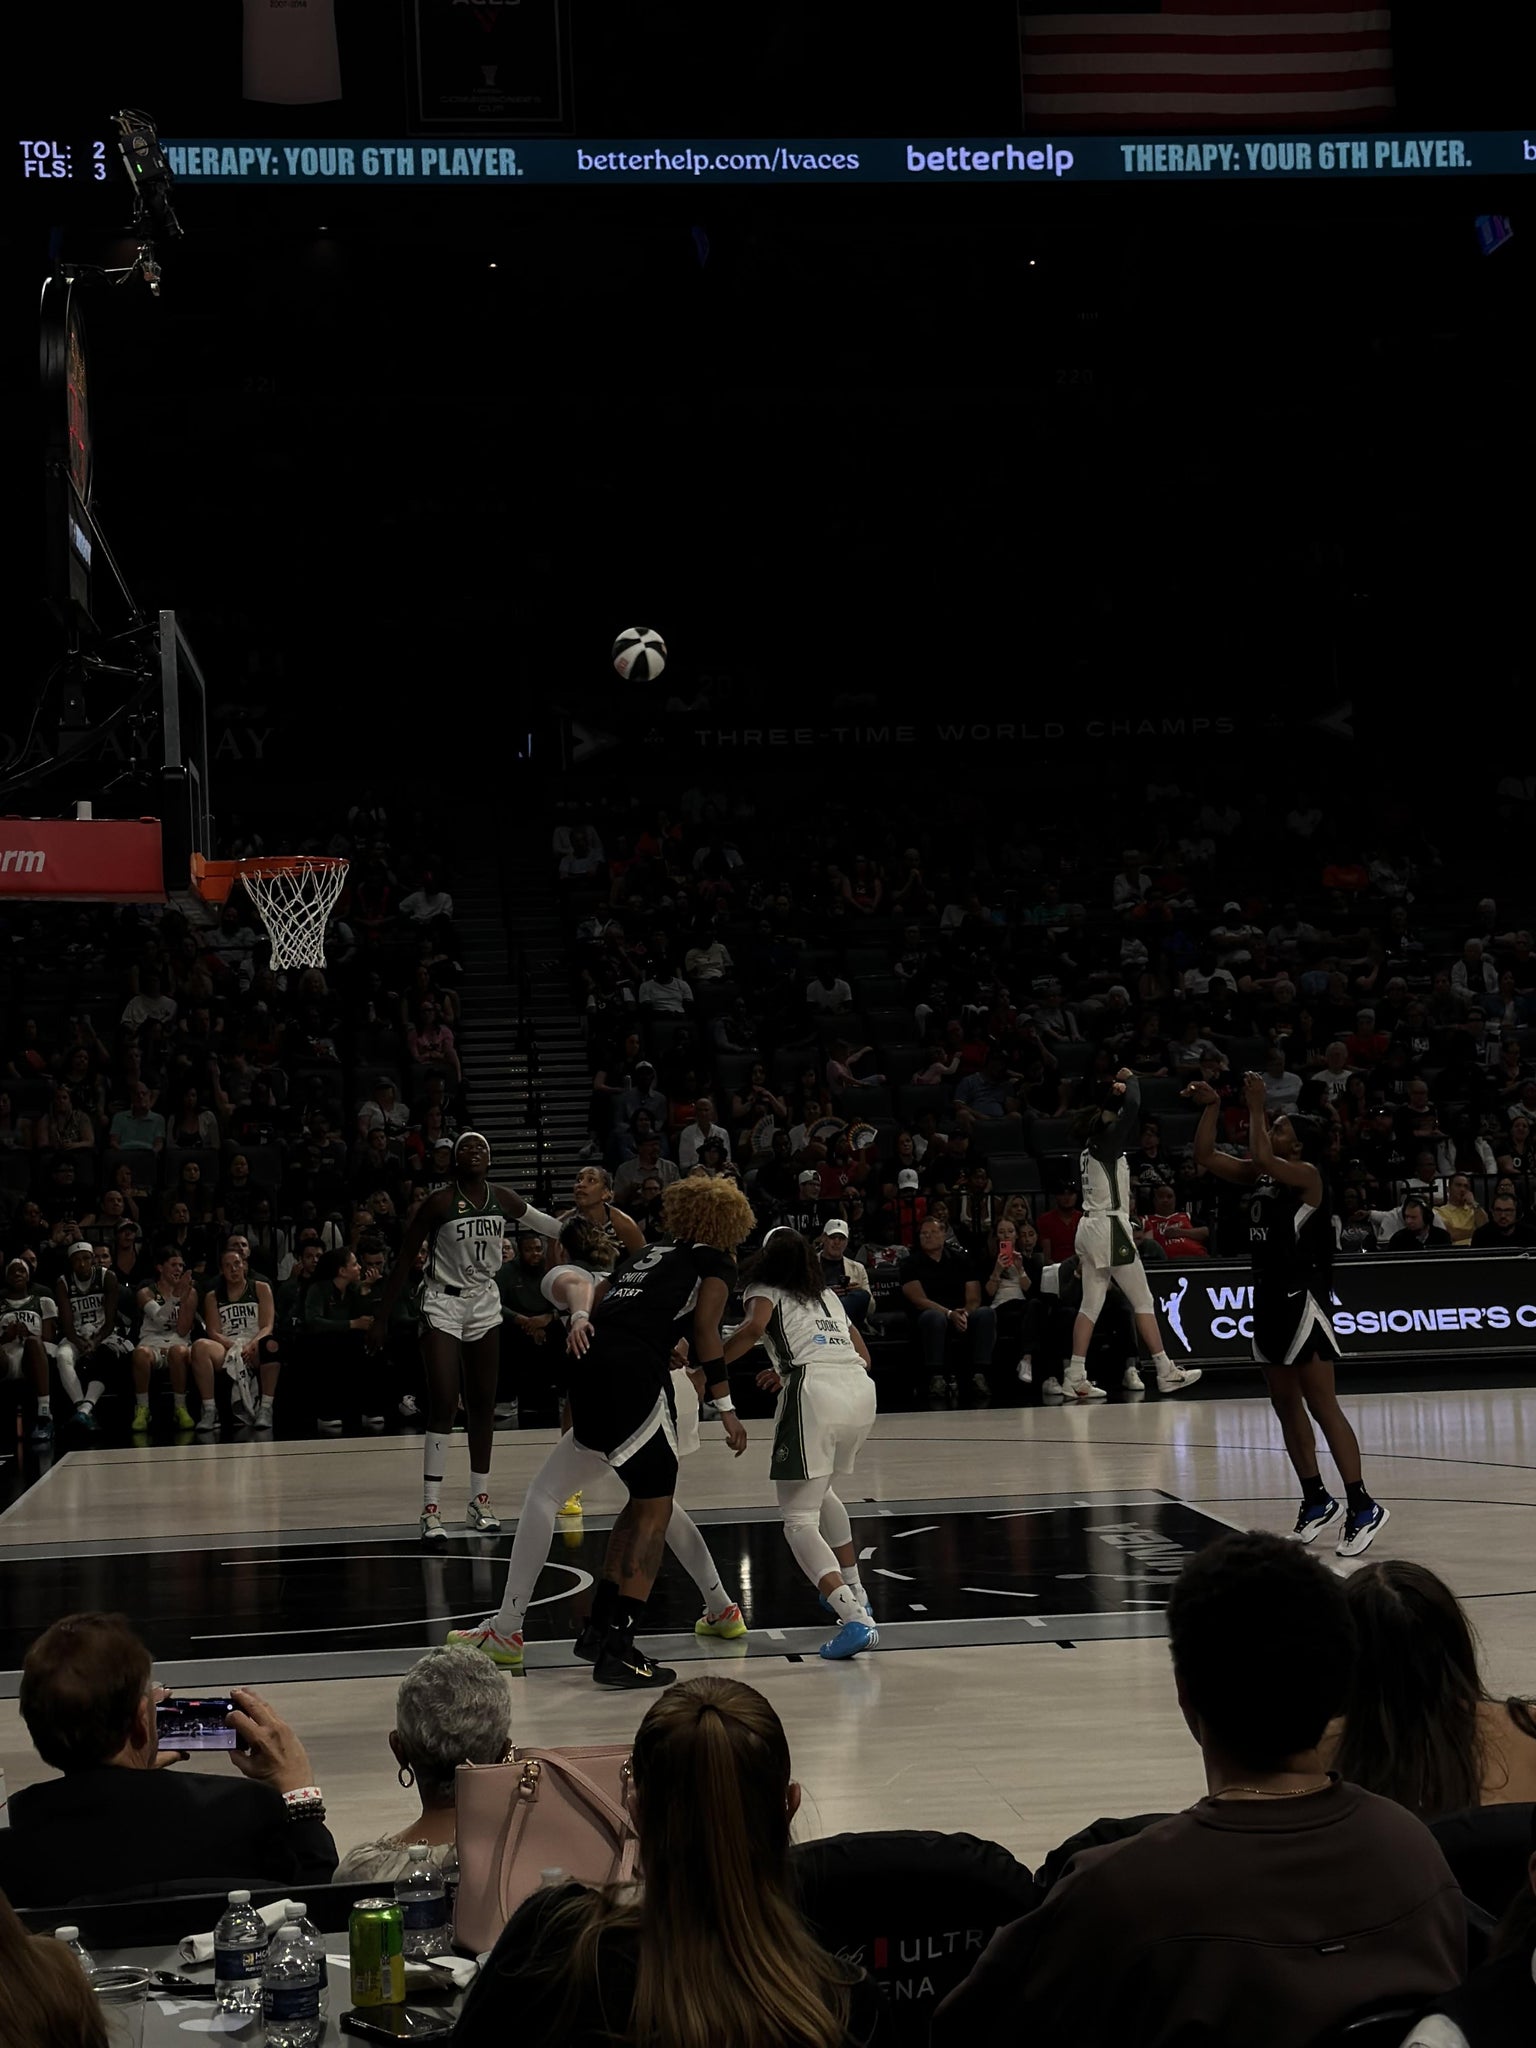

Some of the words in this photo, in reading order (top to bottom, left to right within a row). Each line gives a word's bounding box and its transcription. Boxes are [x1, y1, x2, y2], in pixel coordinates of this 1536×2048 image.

[19, 141, 72, 159] TOL:
[93, 141, 106, 159] 2
[163, 147, 279, 176] HERAPY:
[284, 147, 355, 176] YOUR
[362, 147, 415, 176] 6TH
[420, 147, 524, 176] PLAYER.
[577, 148, 860, 175] betterhelp.com/lvaces
[906, 144, 1074, 176] betterhelp
[1120, 143, 1240, 172] THERAPY:
[1245, 143, 1312, 171] YOUR
[1318, 141, 1368, 170] 6TH
[1374, 140, 1472, 168] PLAYER.
[24, 160, 73, 178] FLS:
[94, 163, 107, 180] 3
[214, 727, 276, 761] AY
[695, 726, 915, 746] THREE-TIME
[937, 722, 1066, 742] WORLD
[1086, 717, 1235, 737] CHAMPS
[0, 850, 46, 873] rm
[456, 1219, 502, 1241] STORM
[474, 1241, 488, 1261] 11
[633, 1246, 677, 1271] 3
[618, 1271, 649, 1284] SMITH
[613, 1287, 644, 1297] AT&T
[221, 1305, 256, 1323] STORM
[899, 1928, 985, 1964] ULTR
[876, 1975, 936, 2001] ENA
